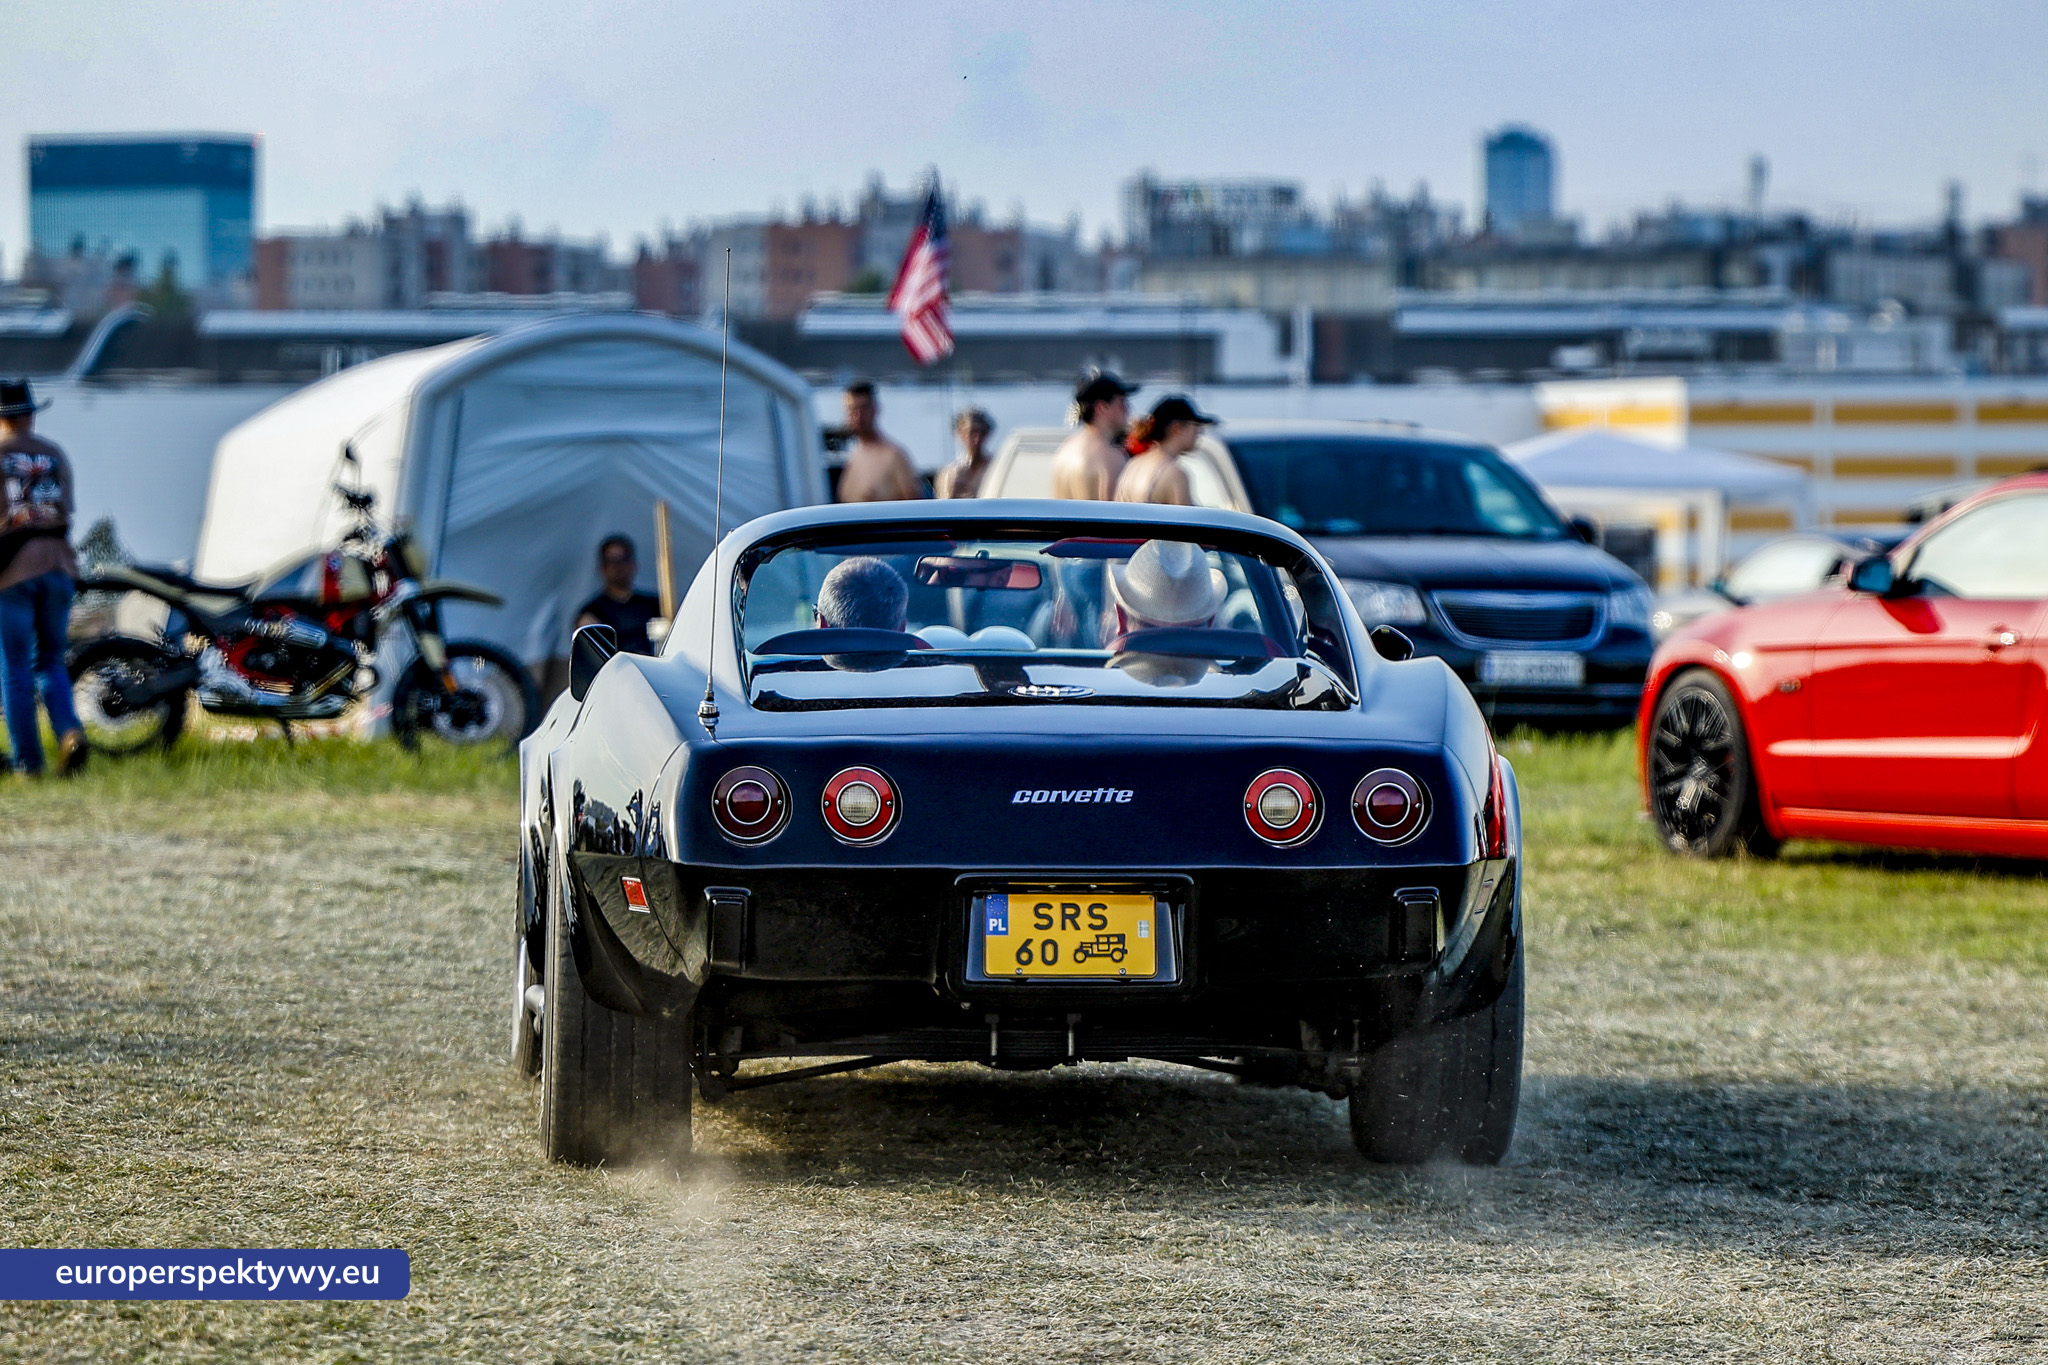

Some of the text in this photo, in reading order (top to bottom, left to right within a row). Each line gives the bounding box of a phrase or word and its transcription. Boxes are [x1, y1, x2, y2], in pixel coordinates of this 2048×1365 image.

[989, 918, 1007, 932] PL
[1033, 903, 1108, 931] SRS
[1016, 938, 1059, 966] 60
